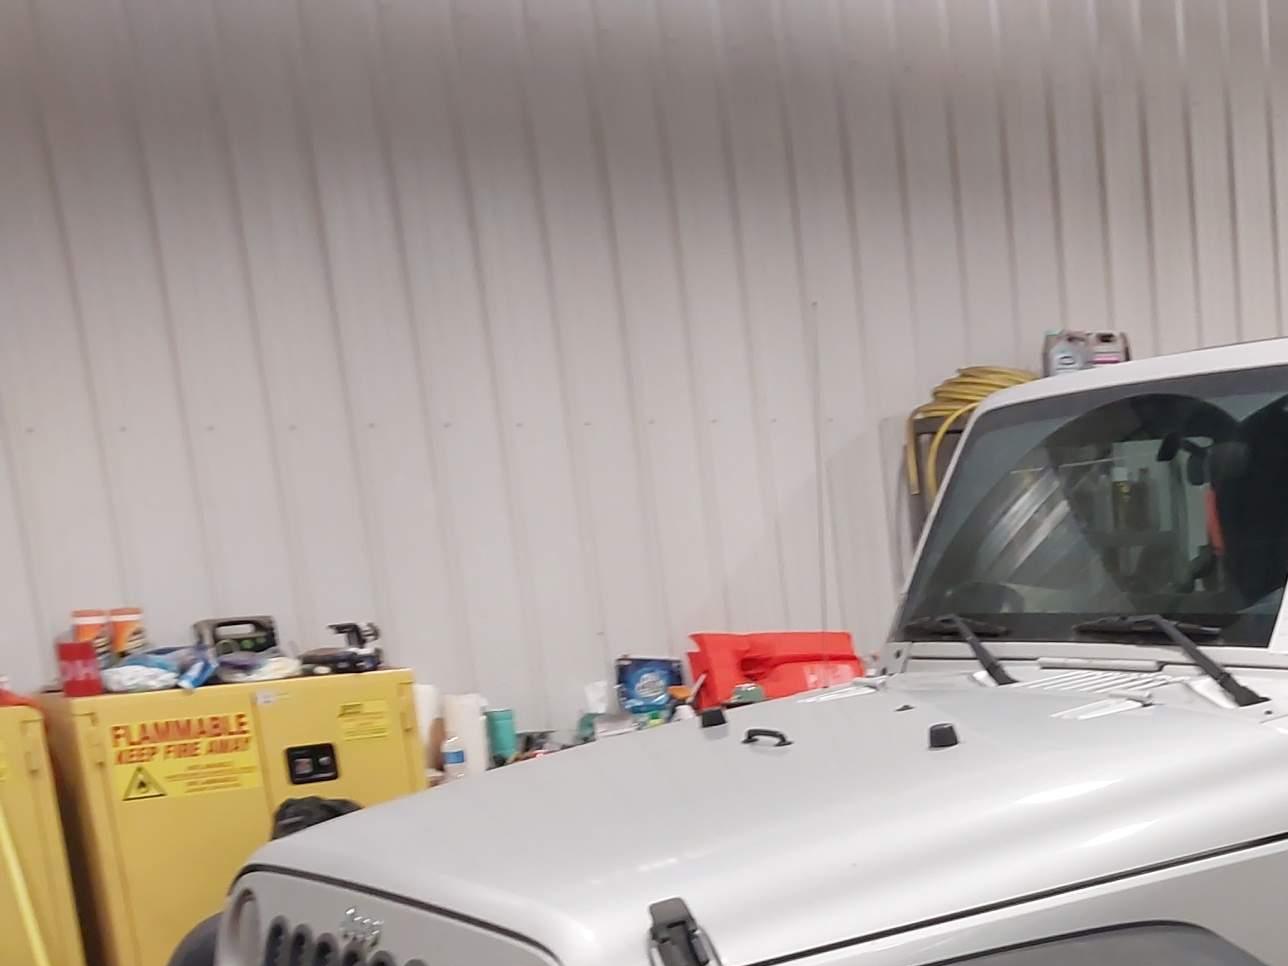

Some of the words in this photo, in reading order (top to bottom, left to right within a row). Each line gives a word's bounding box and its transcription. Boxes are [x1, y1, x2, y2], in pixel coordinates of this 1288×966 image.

[111, 712, 249, 748] FLAMMABLE
[114, 746, 157, 765] KEEP
[163, 741, 200, 760] FIRE
[206, 736, 250, 755] AWAY
